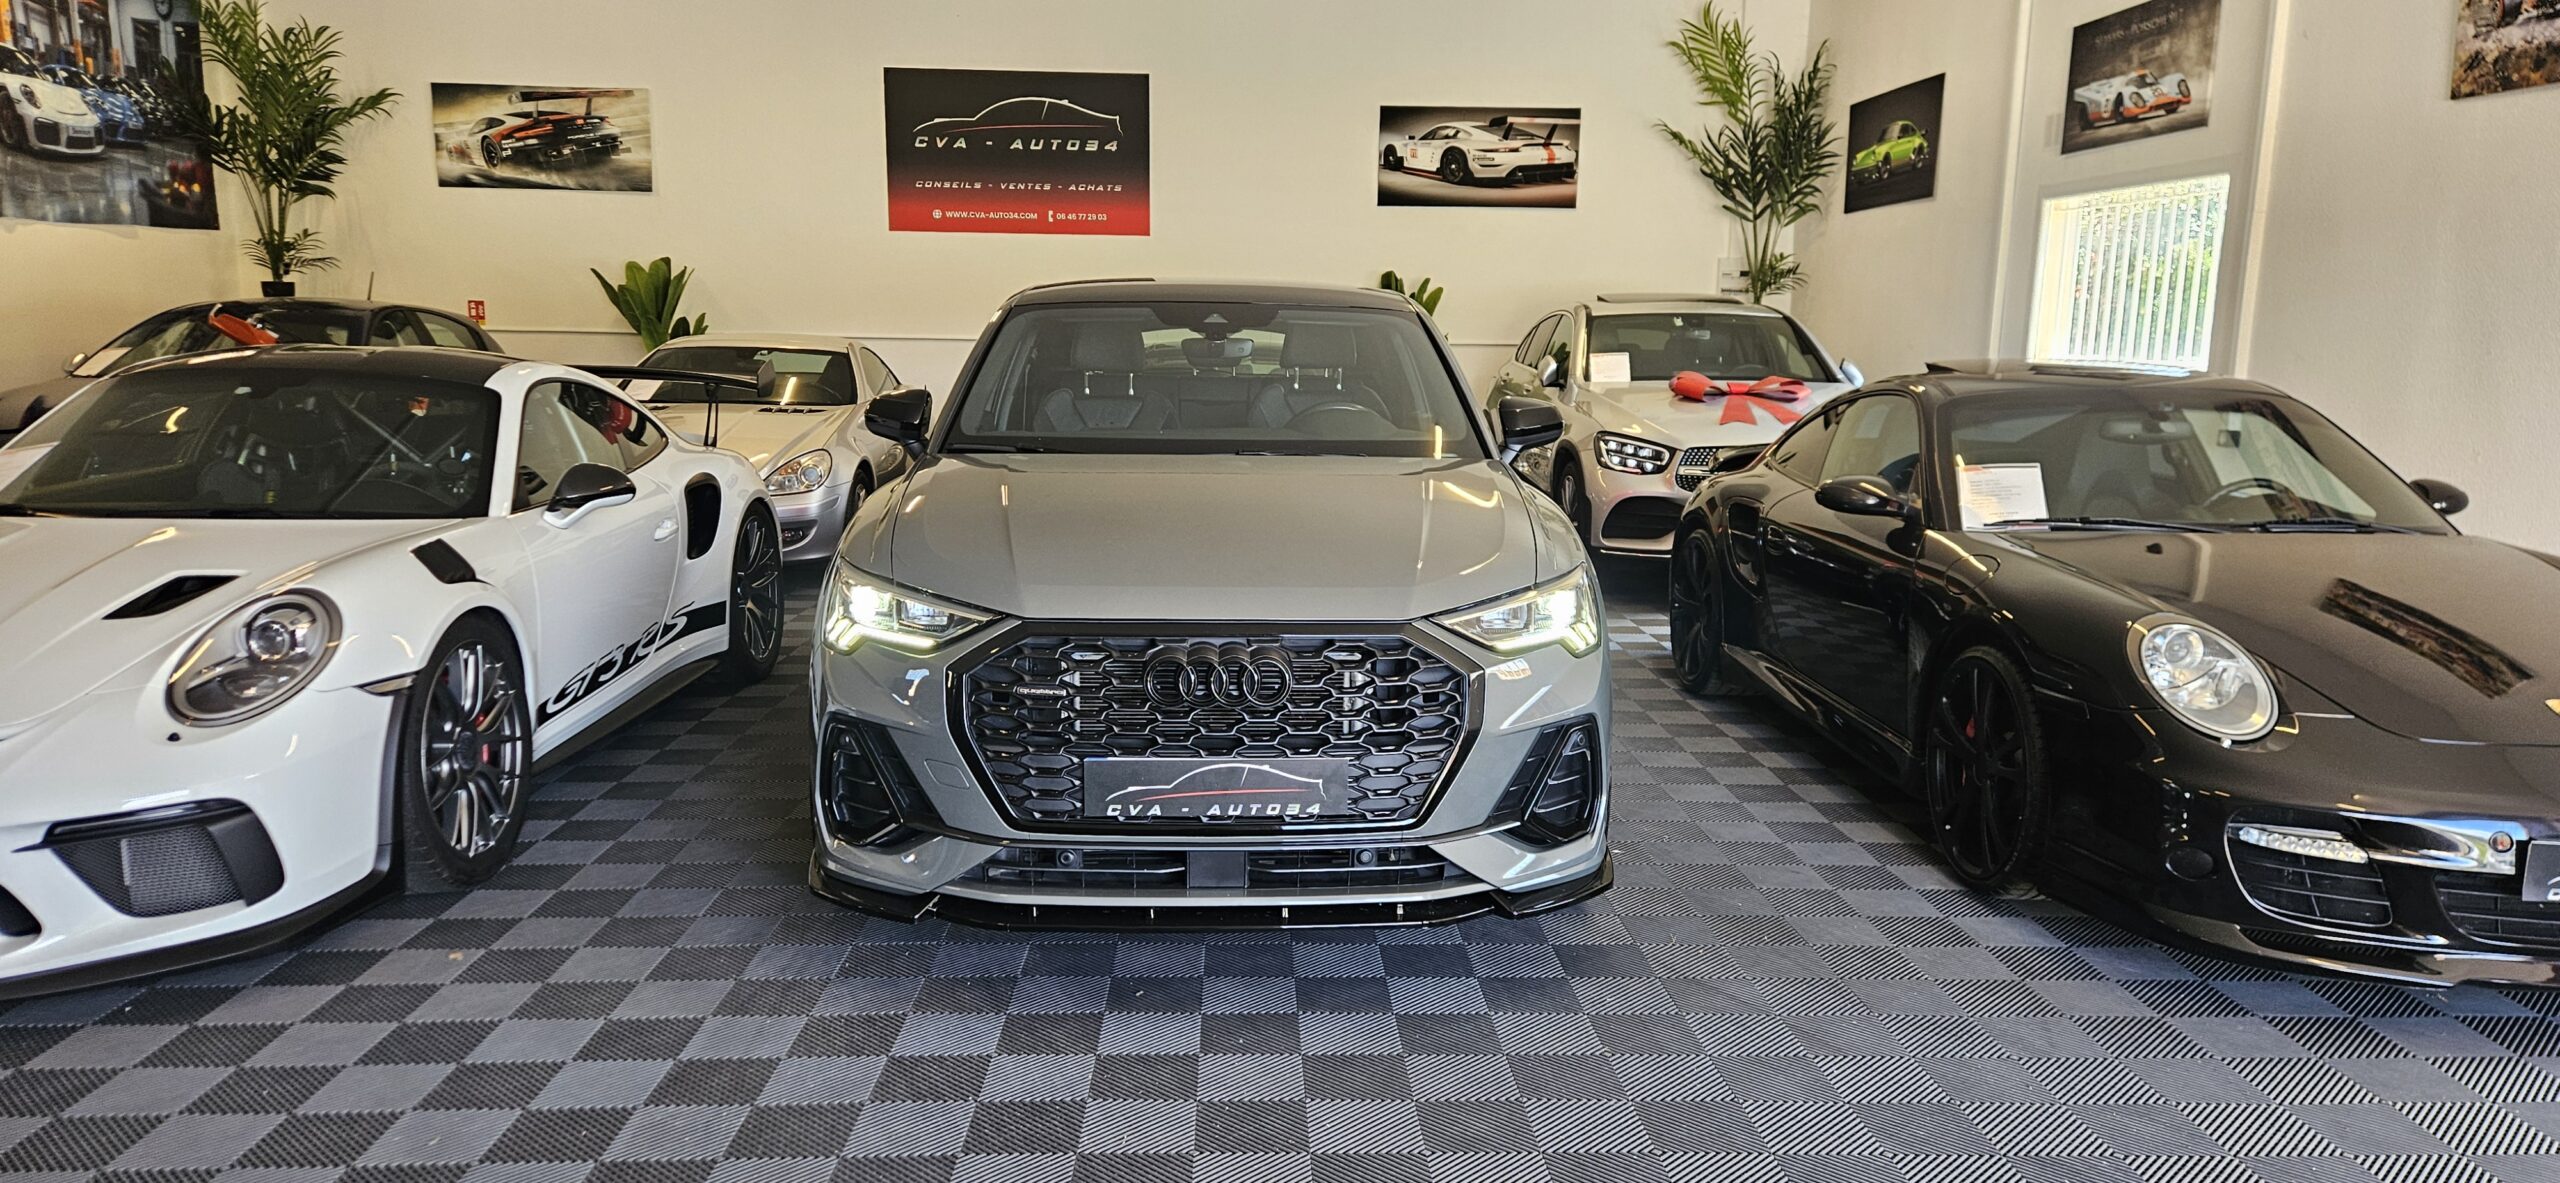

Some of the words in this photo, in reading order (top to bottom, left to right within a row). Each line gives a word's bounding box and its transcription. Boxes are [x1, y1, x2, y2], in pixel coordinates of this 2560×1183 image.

[914, 136, 967, 149] CVA
[1009, 138, 1119, 152] AUTO34
[915, 180, 983, 189] CONSEILS
[1000, 182, 1051, 190] VENTES
[1068, 183, 1123, 192] ACHATS
[945, 211, 1038, 220] WWW.CVA-AUTO34.COM
[1077, 213, 1087, 221] 77
[1097, 213, 1107, 221] 03
[545, 643, 625, 714] GT3
[629, 600, 696, 665] RS
[1106, 804, 1162, 816] CVA
[1206, 803, 1321, 816] AUTO34
